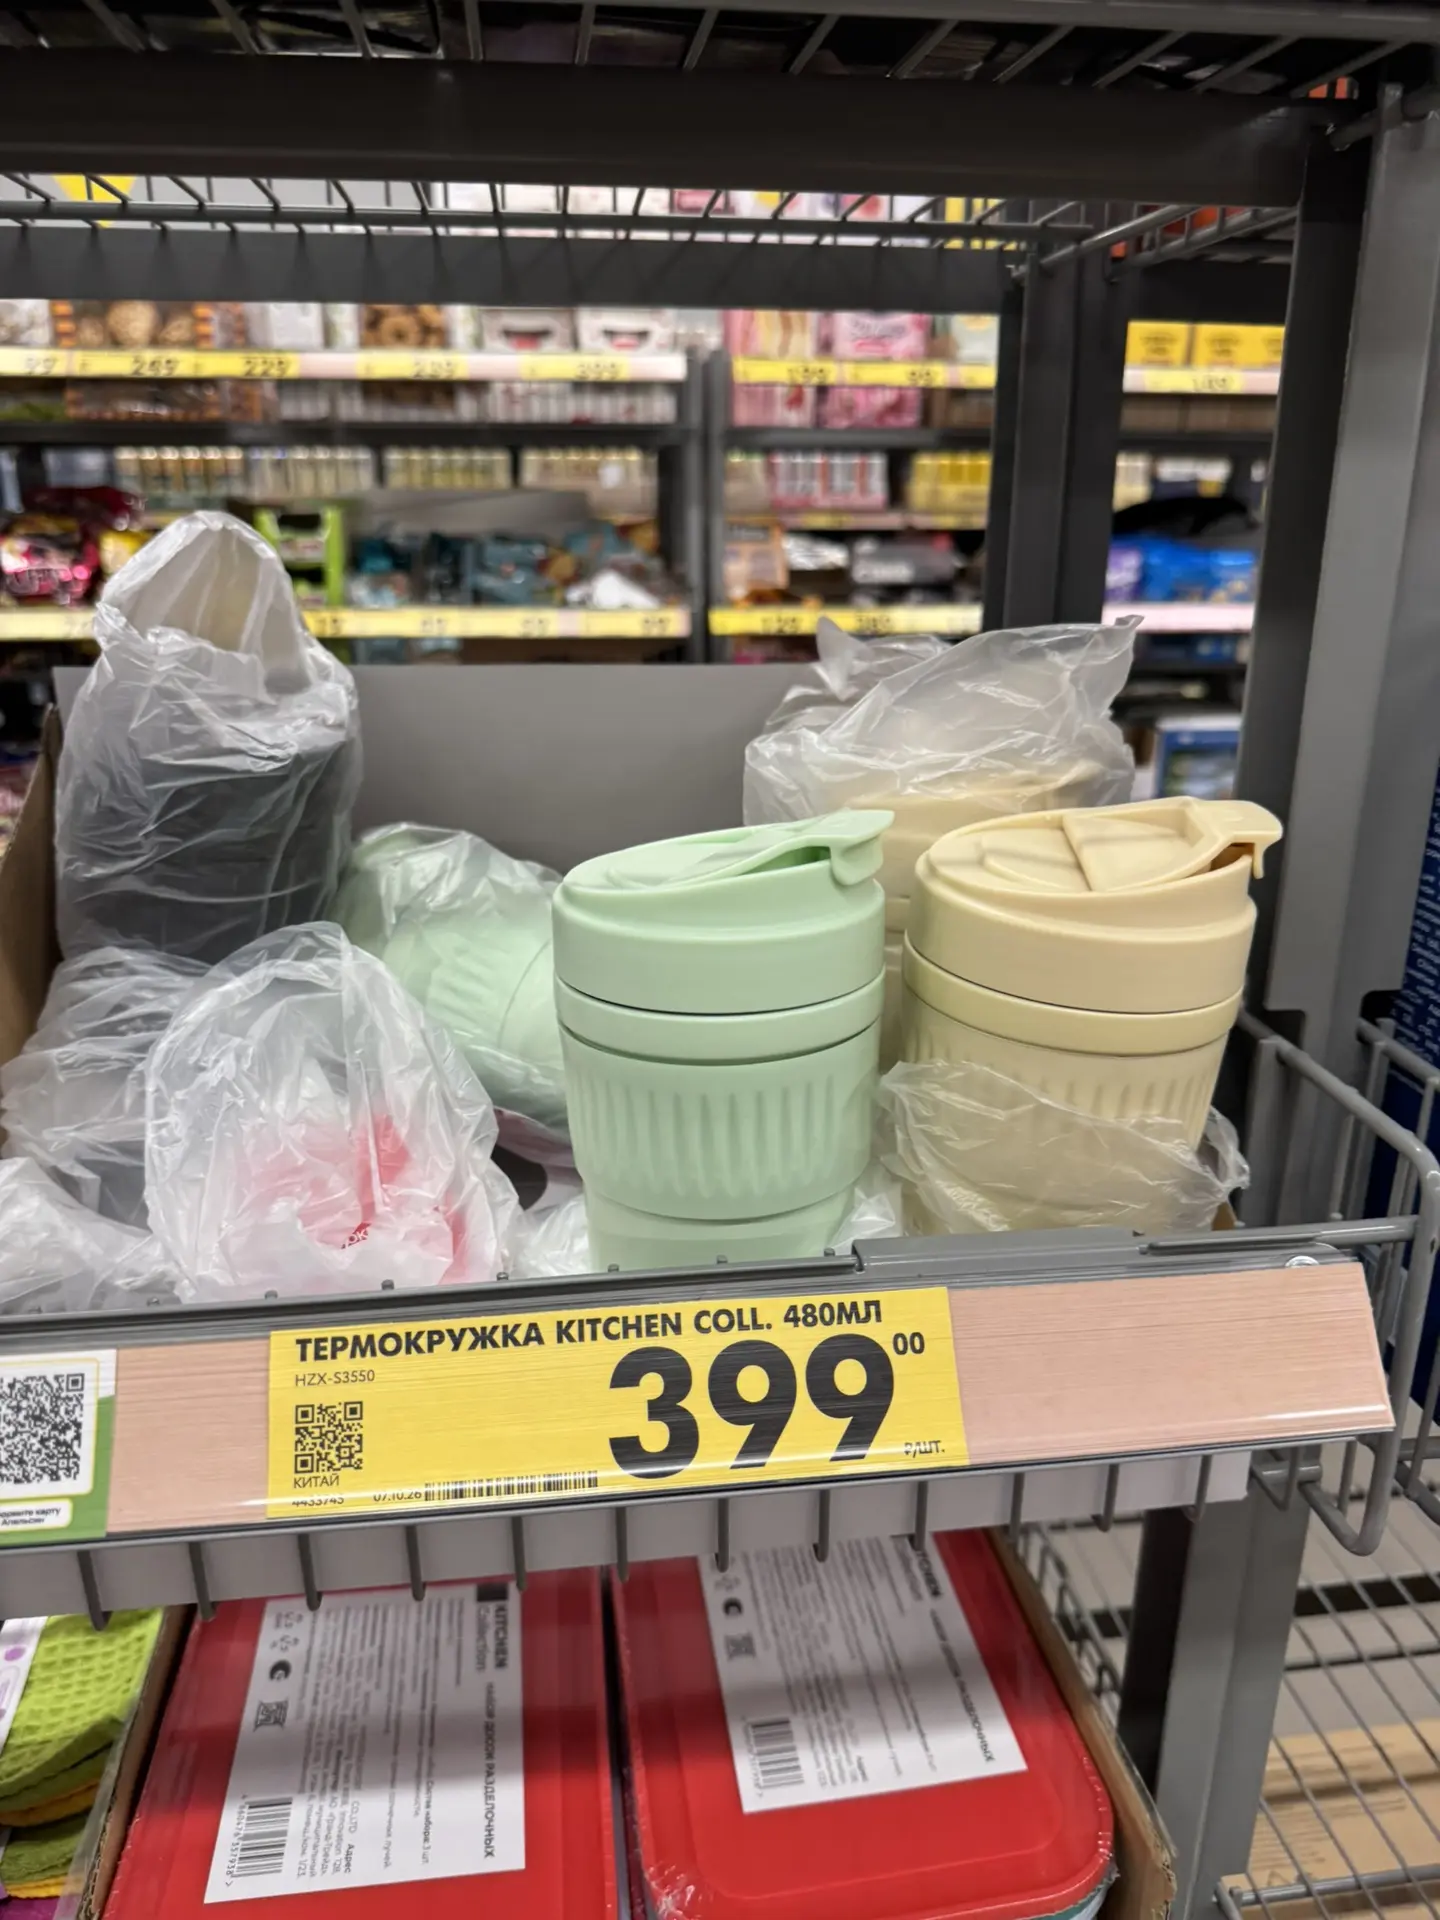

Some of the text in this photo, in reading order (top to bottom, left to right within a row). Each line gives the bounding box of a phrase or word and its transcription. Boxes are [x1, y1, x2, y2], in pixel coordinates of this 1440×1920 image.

[296, 1299, 882, 1362] ТЕРМОКРУЖКА KITCHEN COLL. 480МЛ
[295, 1369, 376, 1387] HZX-S3550
[608, 1332, 925, 1480] 399 00
[293, 1473, 340, 1489] КИТАЙ
[494, 1604, 508, 1669] KITCHEN
[484, 1762, 496, 1859] РАЗДЕЛОЧНЫХ
